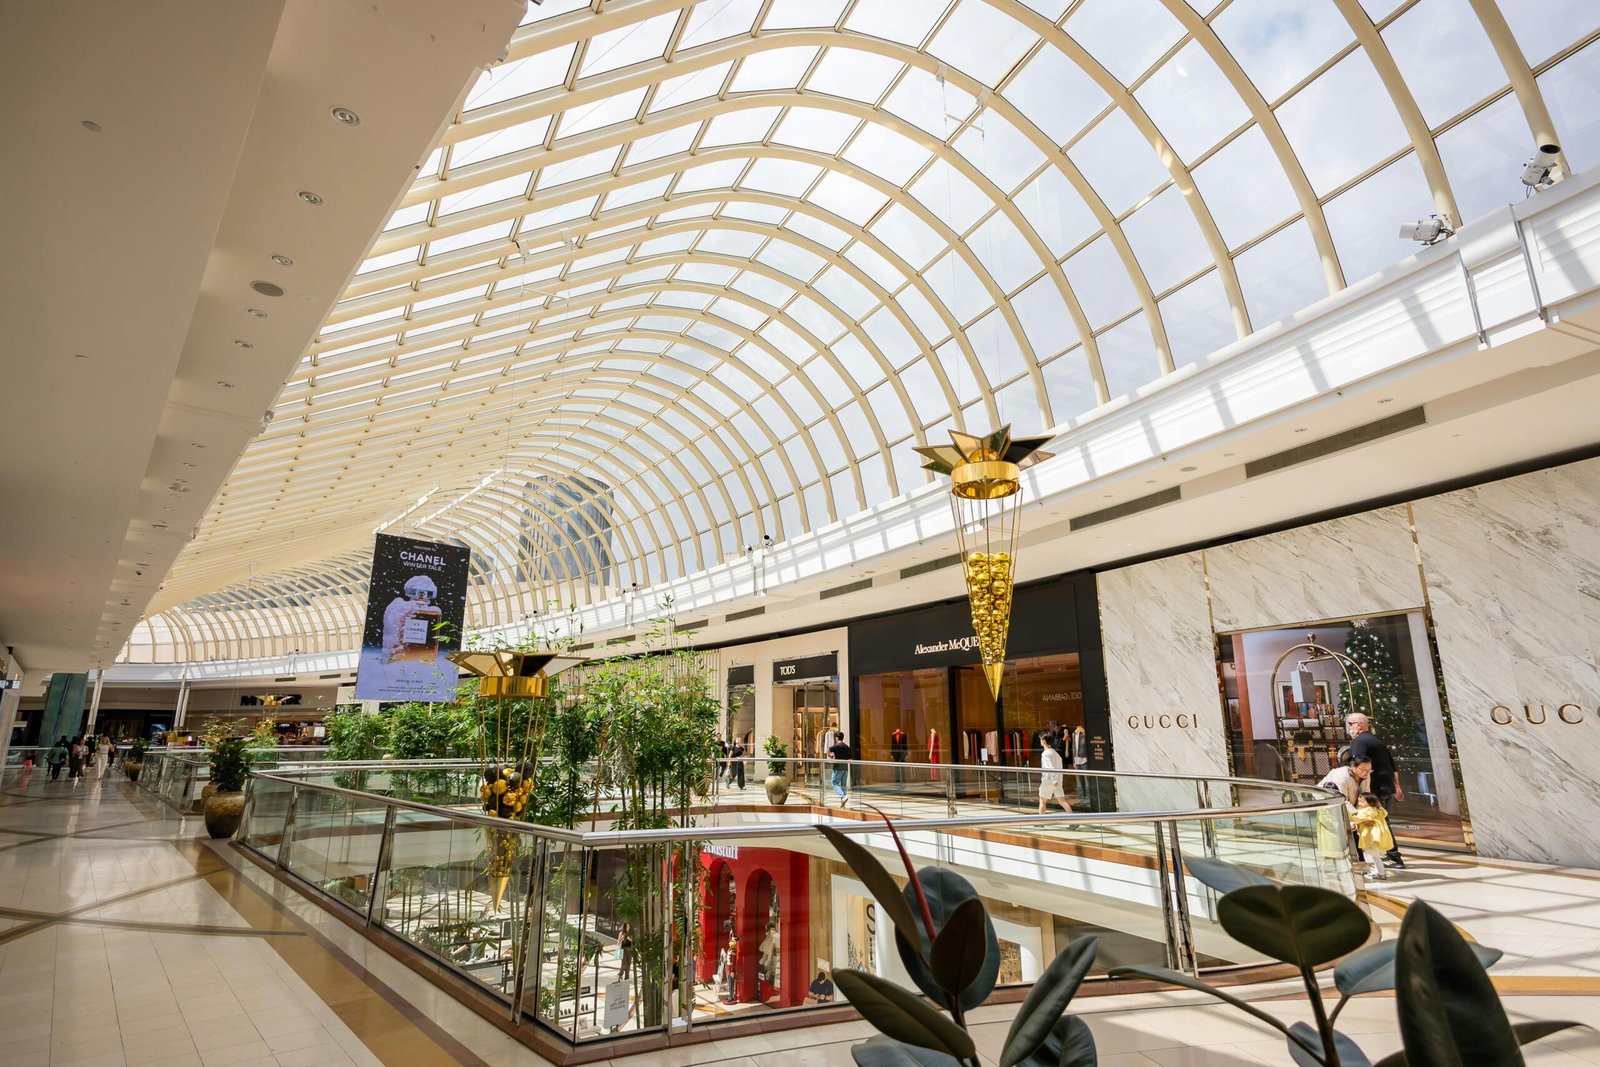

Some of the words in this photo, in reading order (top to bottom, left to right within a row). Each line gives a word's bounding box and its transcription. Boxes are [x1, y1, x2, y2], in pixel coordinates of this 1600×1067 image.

[400, 551, 446, 566] CHANEL
[403, 561, 427, 569] WINTER
[428, 564, 442, 572] TALE
[914, 641, 948, 655] Alexander
[948, 635, 980, 651] McQUE
[240, 694, 302, 706] MER
[1128, 714, 1198, 729] GUCCI
[1490, 703, 1600, 725] GUC
